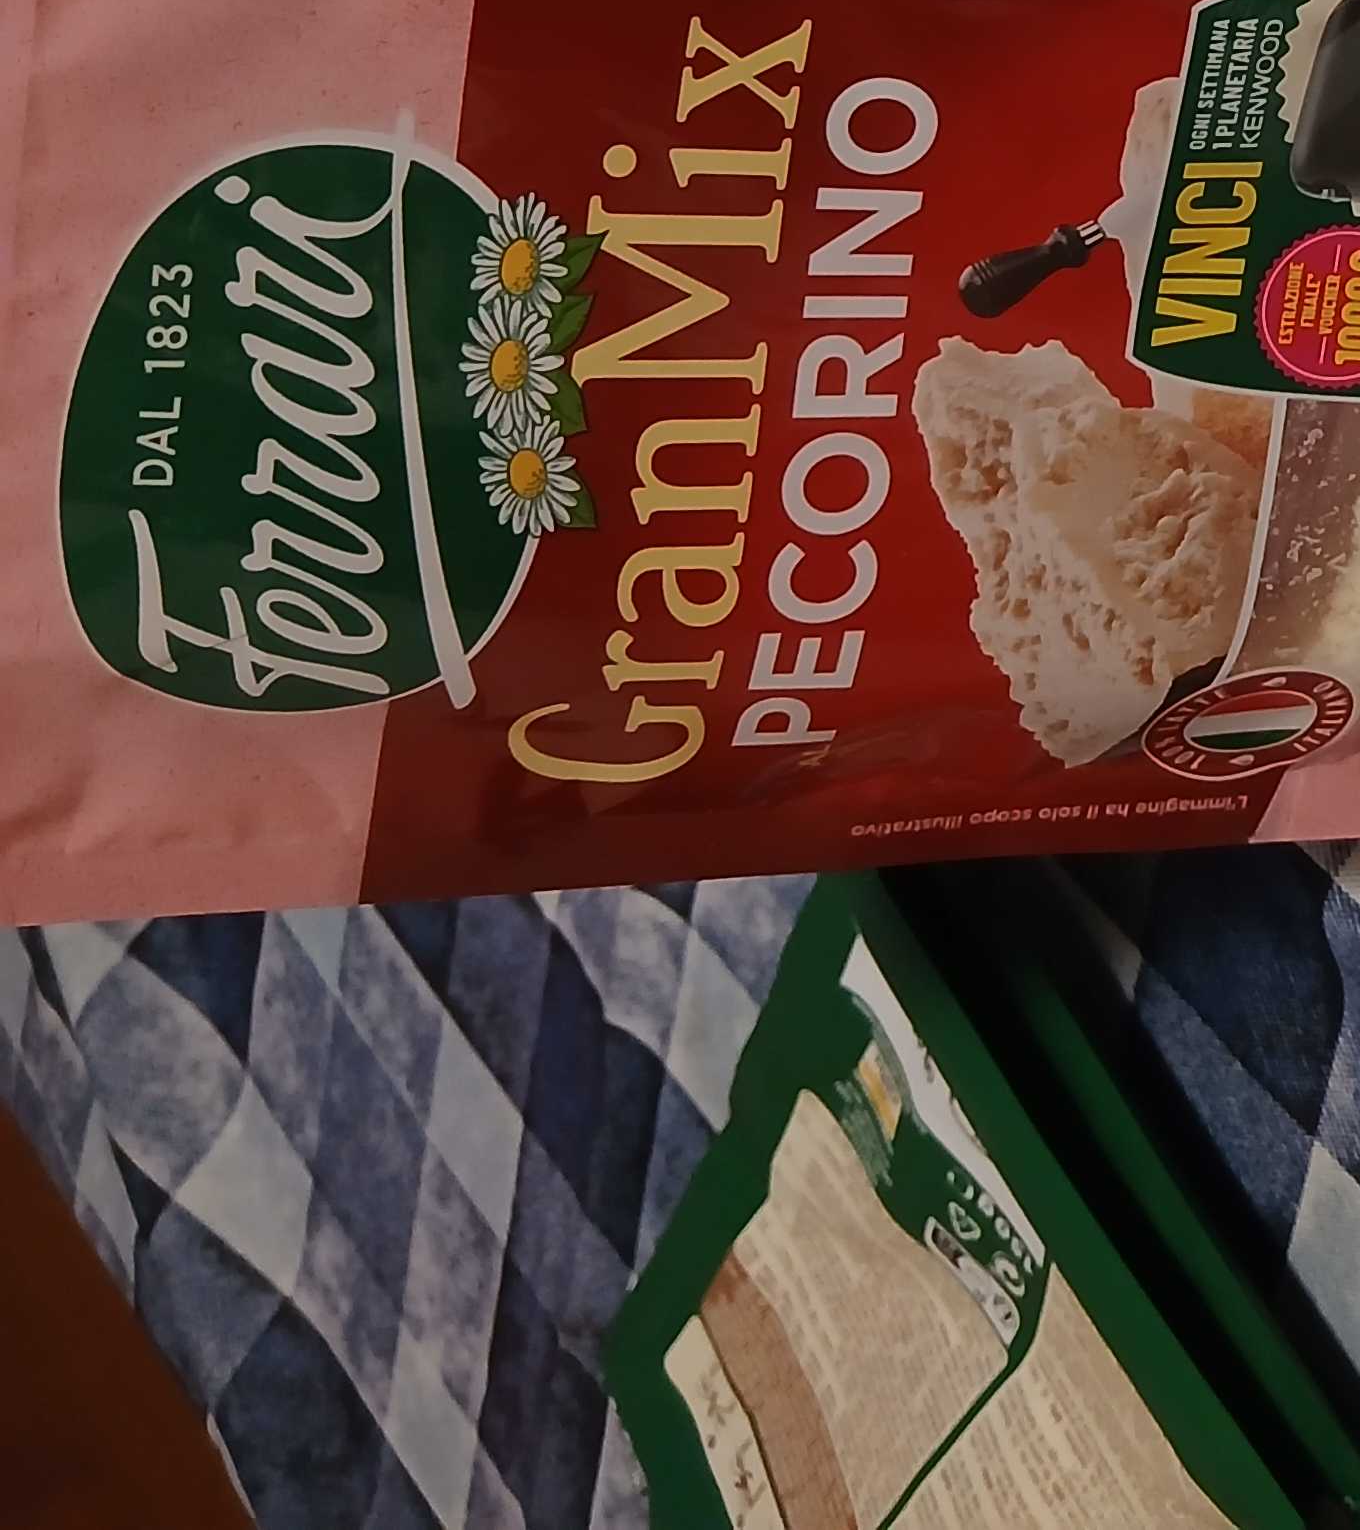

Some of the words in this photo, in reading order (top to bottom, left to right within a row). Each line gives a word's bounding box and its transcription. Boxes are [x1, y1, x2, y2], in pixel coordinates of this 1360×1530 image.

[1198, 19, 1230, 109] SETTIMANA
[1216, 18, 1259, 138] PLANETARIA
[1240, 20, 1284, 148] KENWOOD
[1189, 113, 1210, 150] OGNI
[1213, 141, 1233, 150] 1
[1151, 162, 1264, 346] VINCI
[145, 263, 194, 371] 1823
[1278, 262, 1304, 345] ESTRAZIONE
[1319, 275, 1341, 335] VOUCHER
[129, 174, 398, 695] Ferrari
[508, 16, 811, 783] GranMix
[732, 77, 938, 747] PECORINO
[133, 397, 182, 487] DAL
[1293, 680, 1349, 753] ITALIANO
[851, 815, 963, 837] illustrativo
[970, 809, 1032, 826] scopo
[1039, 804, 1081, 820] solo
[1087, 804, 1099, 820] il
[1106, 801, 1129, 817] ha
[1136, 794, 1249, 814] L'immagine
